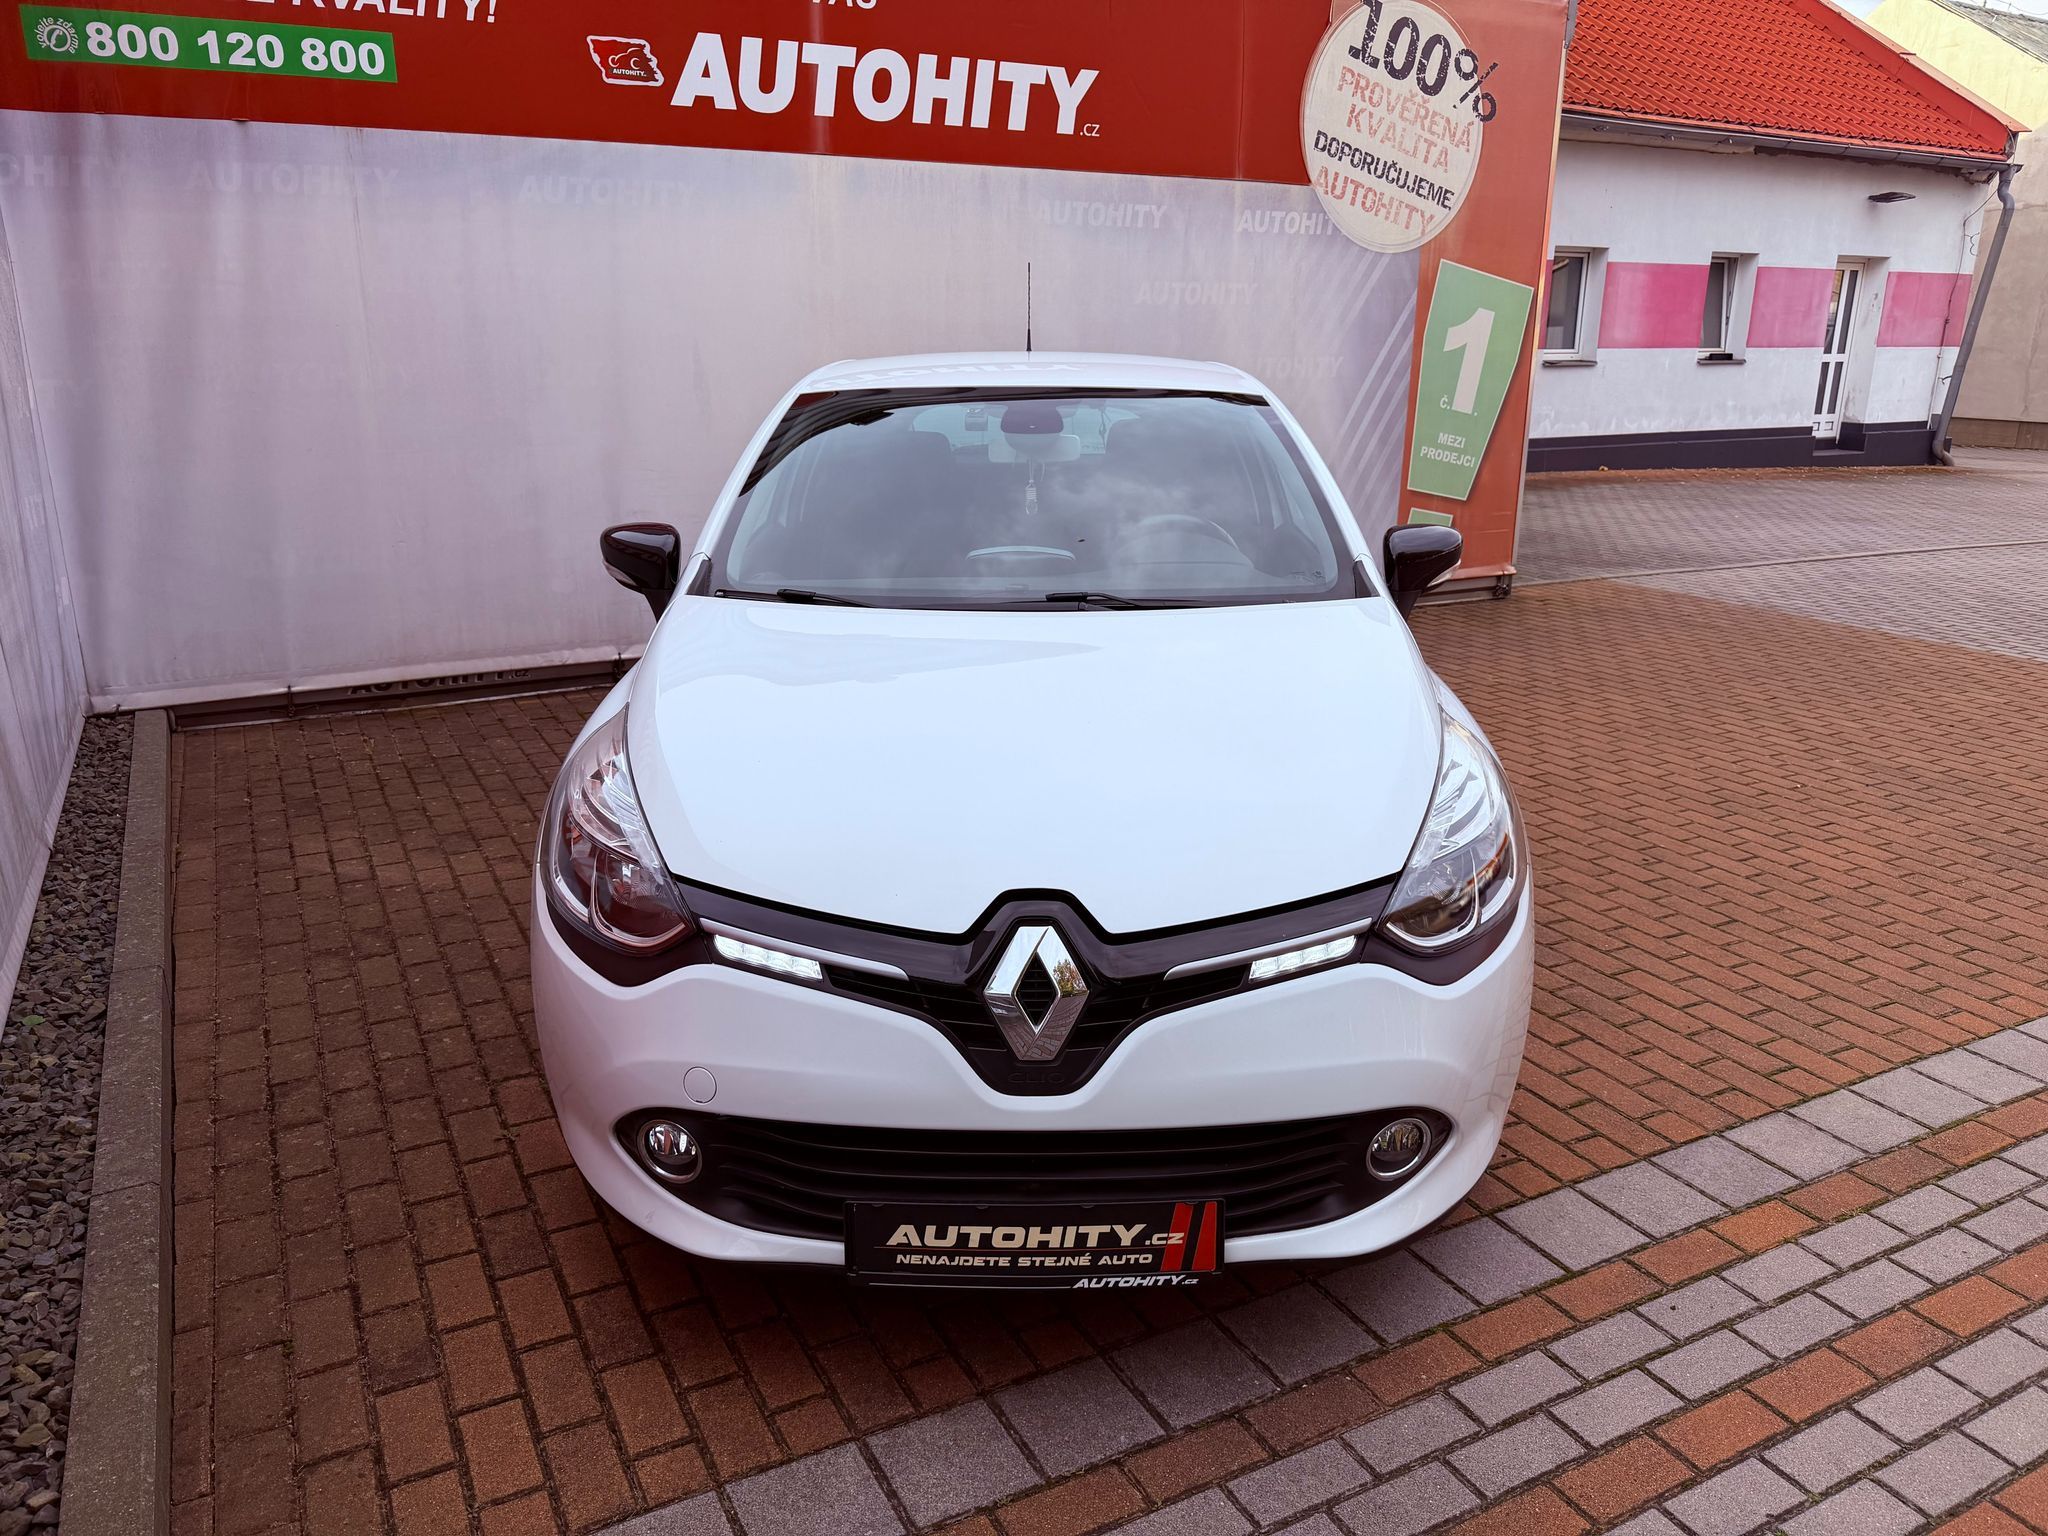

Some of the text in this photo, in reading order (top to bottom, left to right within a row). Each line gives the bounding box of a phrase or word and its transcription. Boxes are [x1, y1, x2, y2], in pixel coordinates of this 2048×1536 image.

[56, 18, 79, 54] zdarma
[87, 22, 386, 75] 800 120 800
[1348, 0, 1499, 124] 100%
[1337, 66, 1474, 152] PROVĚŘENÁ
[1346, 104, 1449, 173] KVALITA
[1313, 130, 1455, 210] DOPORUČUJEME
[1035, 199, 1168, 230] AUTOHITY
[1236, 208, 1343, 237] AUTOHIT
[1314, 166, 1436, 237] AUTOHITY
[1437, 432, 1466, 449] MEZI
[1007, 1071, 1065, 1085] CLIO
[896, 1252, 1153, 1267] NENAJDETE STEJNÉ AUTO
